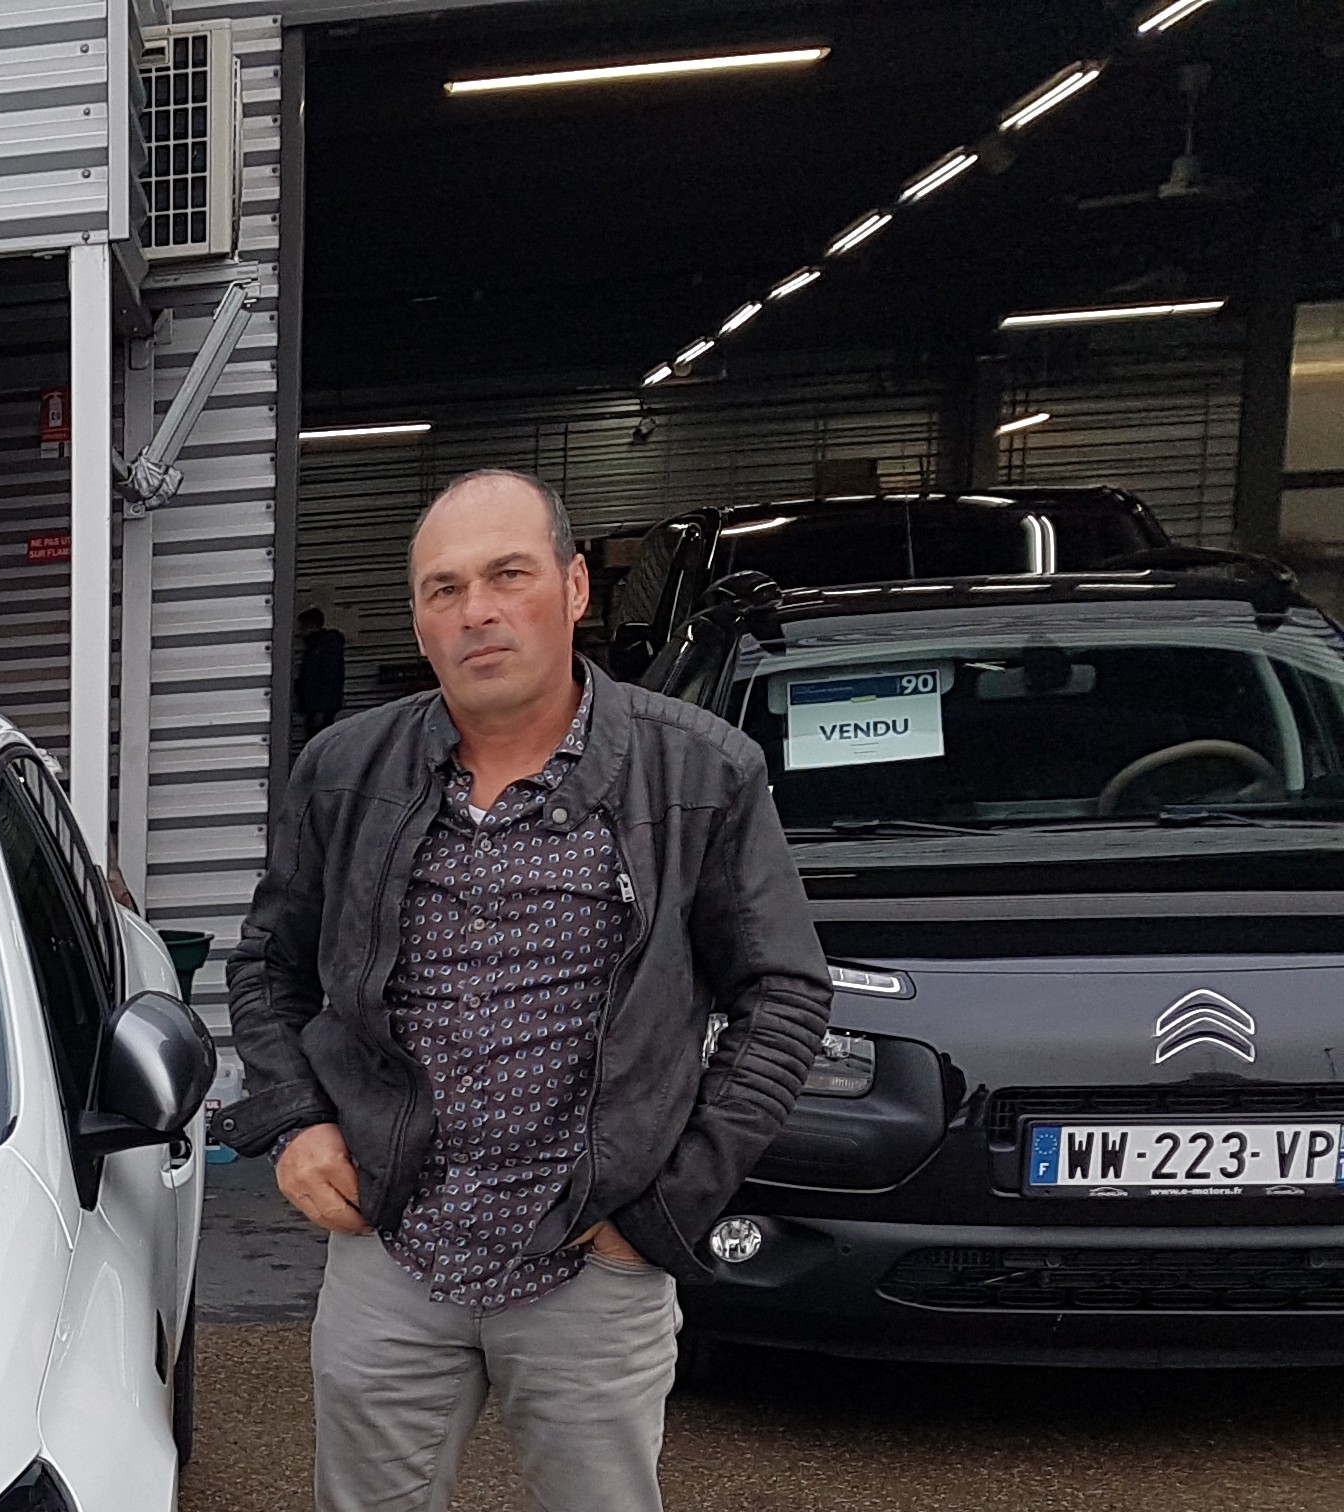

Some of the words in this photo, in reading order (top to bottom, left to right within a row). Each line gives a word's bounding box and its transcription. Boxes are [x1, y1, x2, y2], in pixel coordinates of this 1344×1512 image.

[901, 674, 934, 694] 90
[819, 718, 909, 741] VENDU
[1067, 1130, 1335, 1179] WW-223-VP
[1039, 1163, 1049, 1176] F
